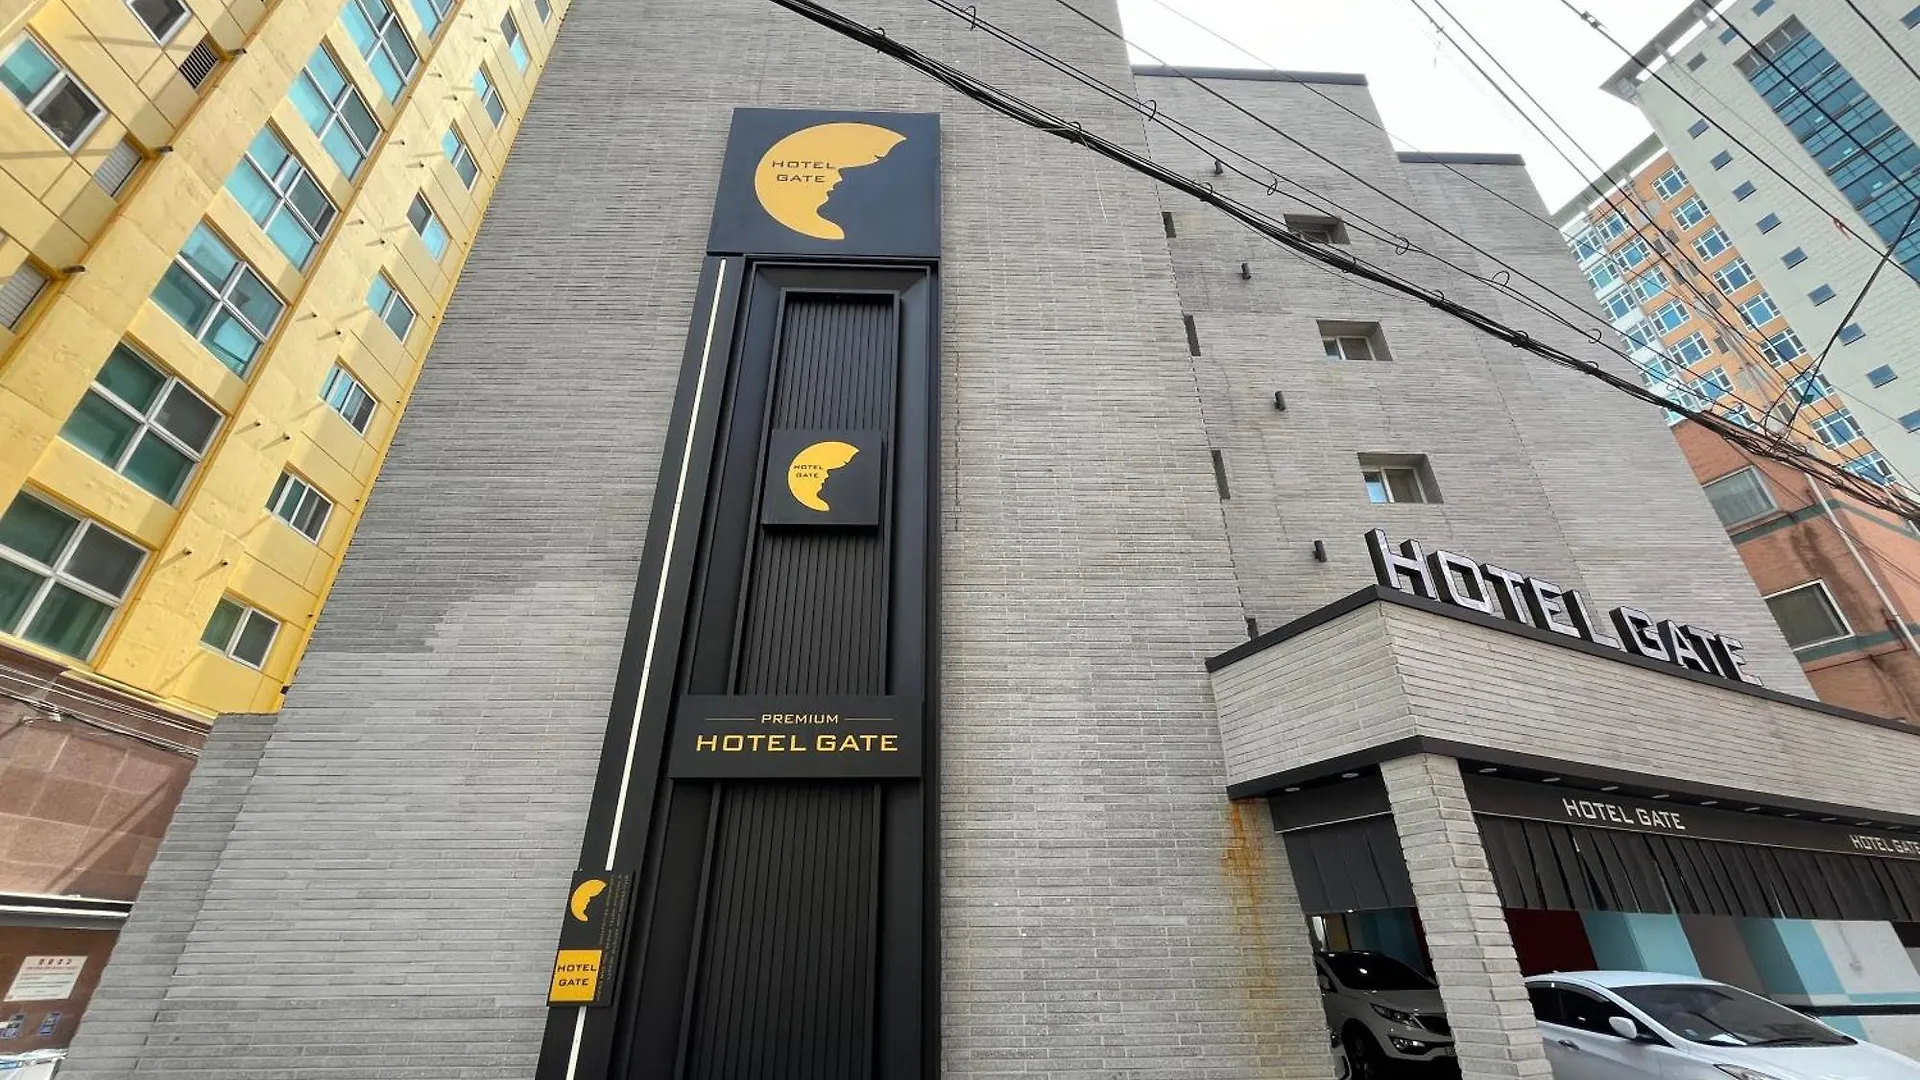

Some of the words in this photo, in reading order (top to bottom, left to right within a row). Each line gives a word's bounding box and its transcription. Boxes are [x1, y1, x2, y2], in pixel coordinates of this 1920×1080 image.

[771, 161, 836, 169] HOTEL
[776, 174, 826, 183] GATE
[1364, 528, 1627, 653] HOTEL
[1609, 605, 1764, 688] GATE
[761, 714, 839, 724] PREMIUM
[696, 735, 807, 752] HOTEL
[816, 735, 898, 752] GATE
[1562, 798, 1635, 824] HOTEL
[1635, 808, 1686, 830] GATE
[1849, 834, 1894, 852] HOTEL
[557, 964, 597, 972] HOTEL
[558, 979, 588, 987] GATE
